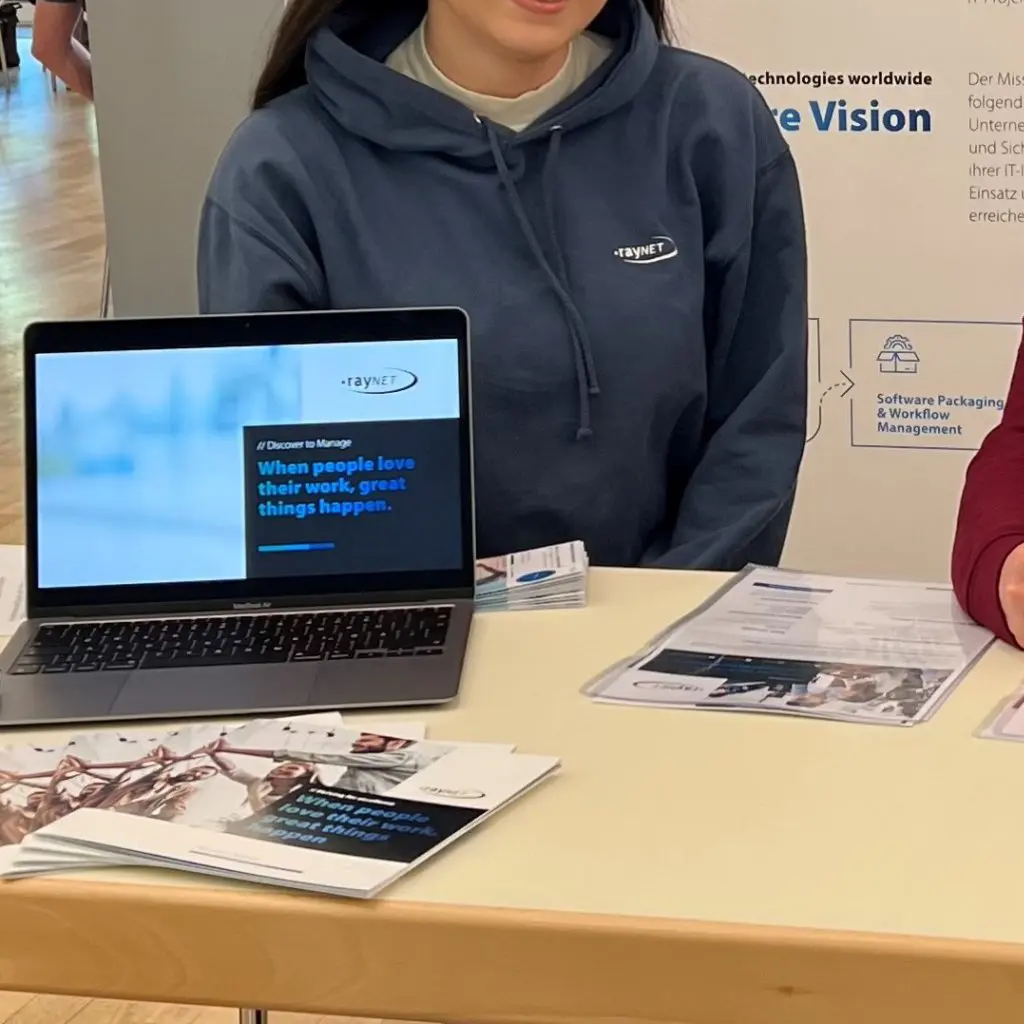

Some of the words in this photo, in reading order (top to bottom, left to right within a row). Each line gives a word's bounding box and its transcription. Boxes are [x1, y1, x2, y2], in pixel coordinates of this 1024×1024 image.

[748, 71, 844, 88] echnologies
[848, 71, 932, 85] worldwide
[968, 72, 993, 86] Der
[968, 94, 1023, 112] folgend
[809, 99, 932, 132] Vision
[969, 140, 996, 154] und
[969, 163, 1001, 177] ihrer
[969, 186, 1017, 200] Einsatz
[876, 393, 934, 406] Software
[937, 395, 1004, 410] Packaging
[876, 407, 887, 418] &
[889, 407, 950, 421] Workflow
[877, 421, 963, 436] Management
[267, 440, 304, 451] Discover
[305, 439, 316, 449] to
[316, 438, 352, 450] Manage
[257, 459, 309, 476] When
[312, 456, 375, 477] people
[378, 455, 416, 471] love
[258, 479, 301, 496] their
[305, 477, 355, 495] work,
[359, 476, 406, 495] great
[258, 500, 316, 519] things
[319, 498, 392, 517] happen.
[278, 803, 324, 819] love
[327, 810, 381, 827] their
[296, 794, 354, 813] When
[354, 805, 430, 824] people
[322, 823, 390, 843] things
